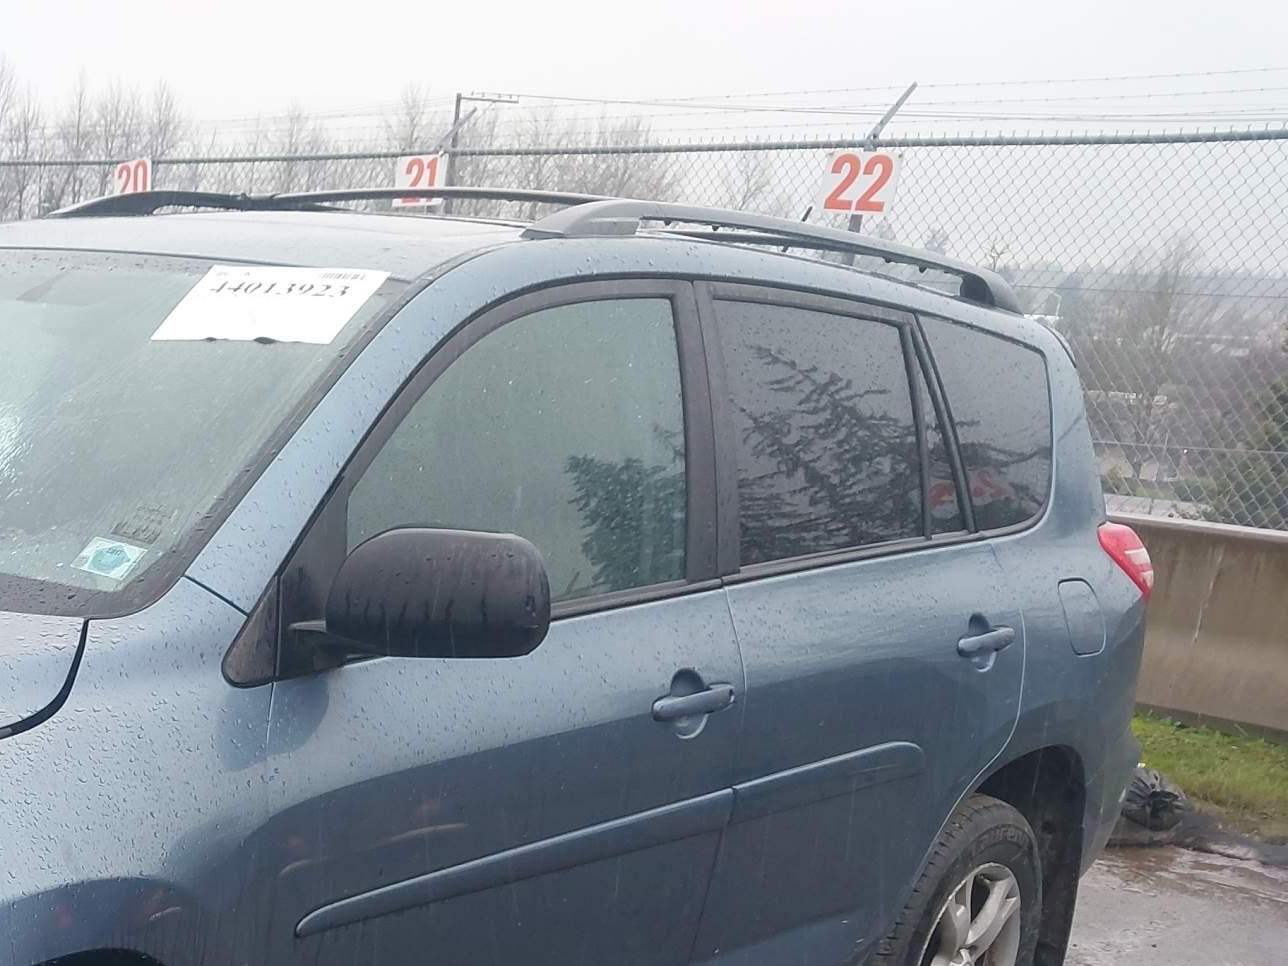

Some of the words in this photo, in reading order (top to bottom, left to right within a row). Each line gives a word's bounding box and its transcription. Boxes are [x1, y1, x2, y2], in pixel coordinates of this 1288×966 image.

[118, 160, 147, 194] 20
[401, 157, 438, 203] 21
[824, 153, 893, 212] 22
